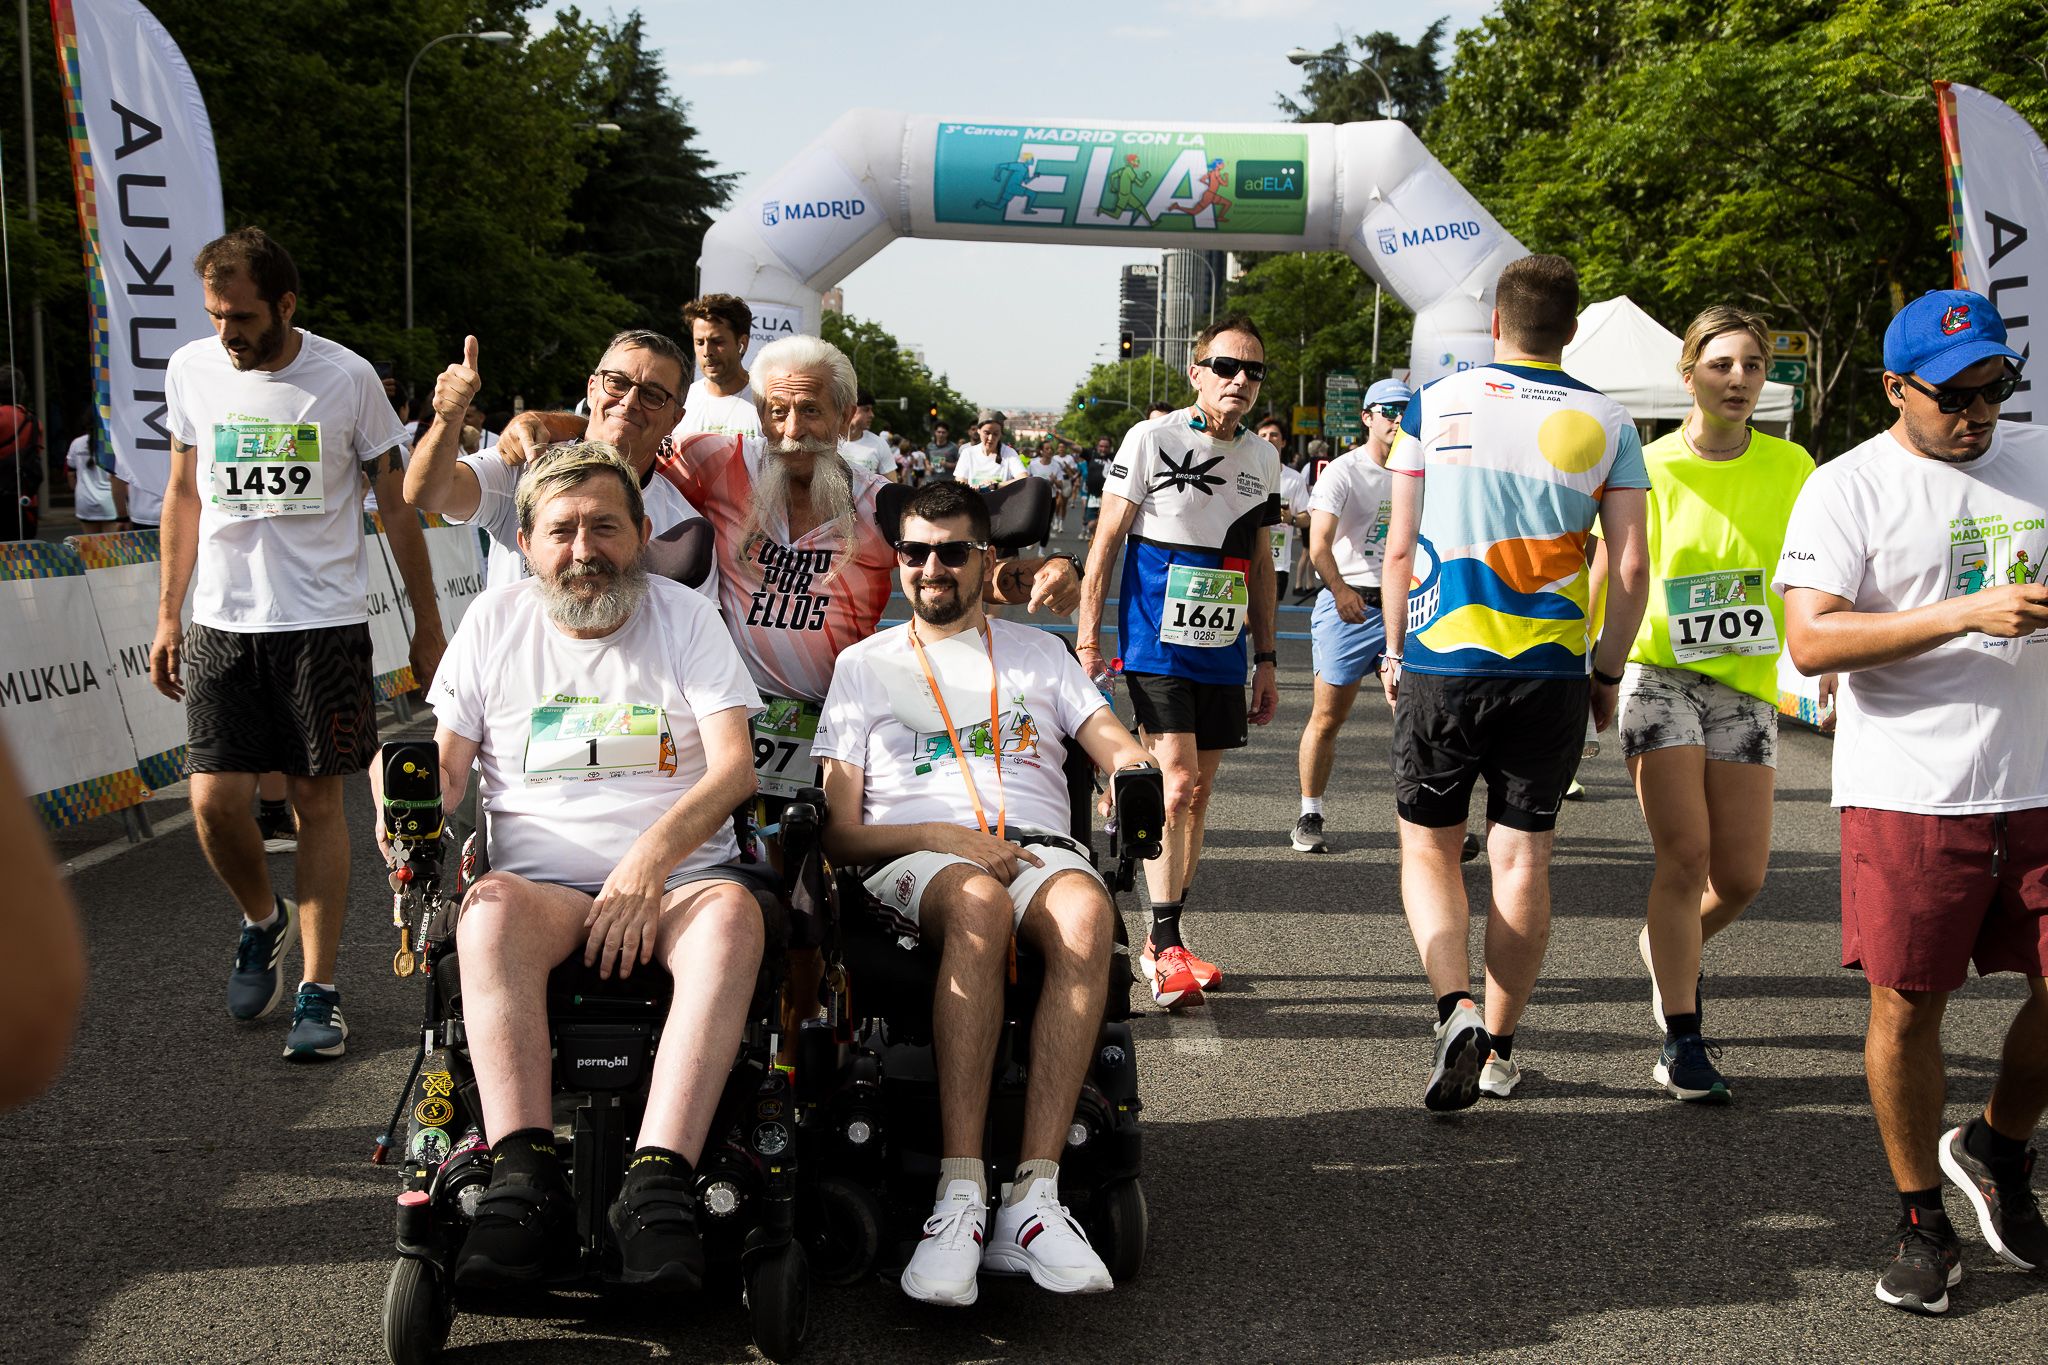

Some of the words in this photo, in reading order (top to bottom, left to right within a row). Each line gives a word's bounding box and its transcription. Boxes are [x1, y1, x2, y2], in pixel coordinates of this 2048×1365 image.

[964, 126, 1018, 137] Carrera
[1023, 127, 1116, 144] MADRID
[1122, 132, 1172, 146] CON
[1175, 134, 1206, 147] LA
[1003, 142, 1217, 230] ELA
[1244, 174, 1294, 192] adELA
[785, 199, 865, 220] MADRID
[1402, 220, 1481, 247] MADRID
[751, 316, 794, 334] KUA
[752, 333, 777, 343] roup
[235, 433, 297, 458] ELA
[226, 466, 311, 495] 1439
[1175, 472, 1201, 481] BROOKS
[1951, 523, 2009, 542] MADRID
[2012, 518, 2046, 532] CON
[1961, 514, 2003, 527] Carrera
[1783, 550, 1816, 562] KUA
[760, 565, 814, 595] POR
[1186, 576, 1233, 600] ELA
[366, 591, 391, 617] KUA
[1689, 579, 1746, 609] ELA
[745, 591, 831, 631] ELLOS
[1173, 602, 1236, 632] 1661
[1193, 630, 1216, 641] 0285
[1678, 609, 1764, 645] 1709
[0, 659, 100, 708] MUKUA
[554, 693, 601, 704] Carrera
[556, 708, 631, 740] ELA
[757, 705, 800, 732] LA
[586, 738, 600, 767] 1
[755, 737, 800, 773] 97
[577, 1056, 628, 1069] permobil
[629, 1154, 672, 1169] ORK
